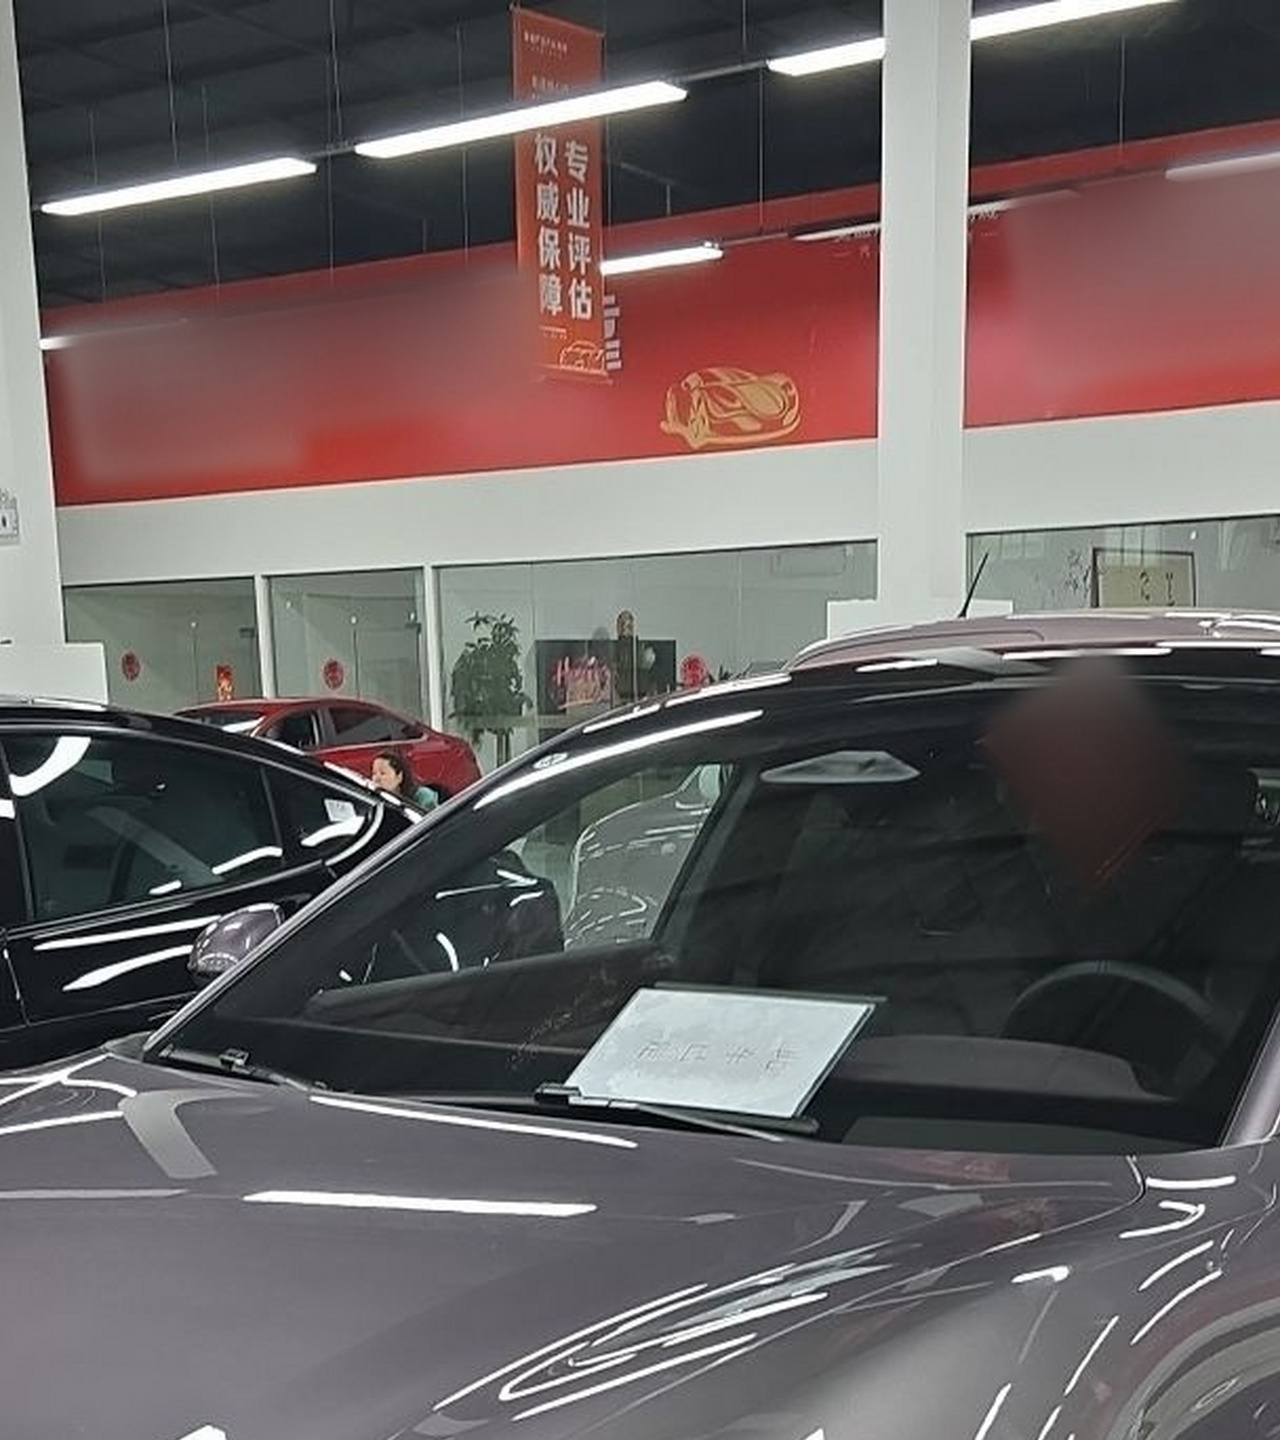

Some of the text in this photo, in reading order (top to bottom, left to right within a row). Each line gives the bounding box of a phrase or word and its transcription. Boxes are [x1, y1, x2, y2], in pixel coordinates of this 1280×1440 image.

[535, 132, 563, 316] 权威保障
[564, 140, 592, 319] 专业评估
